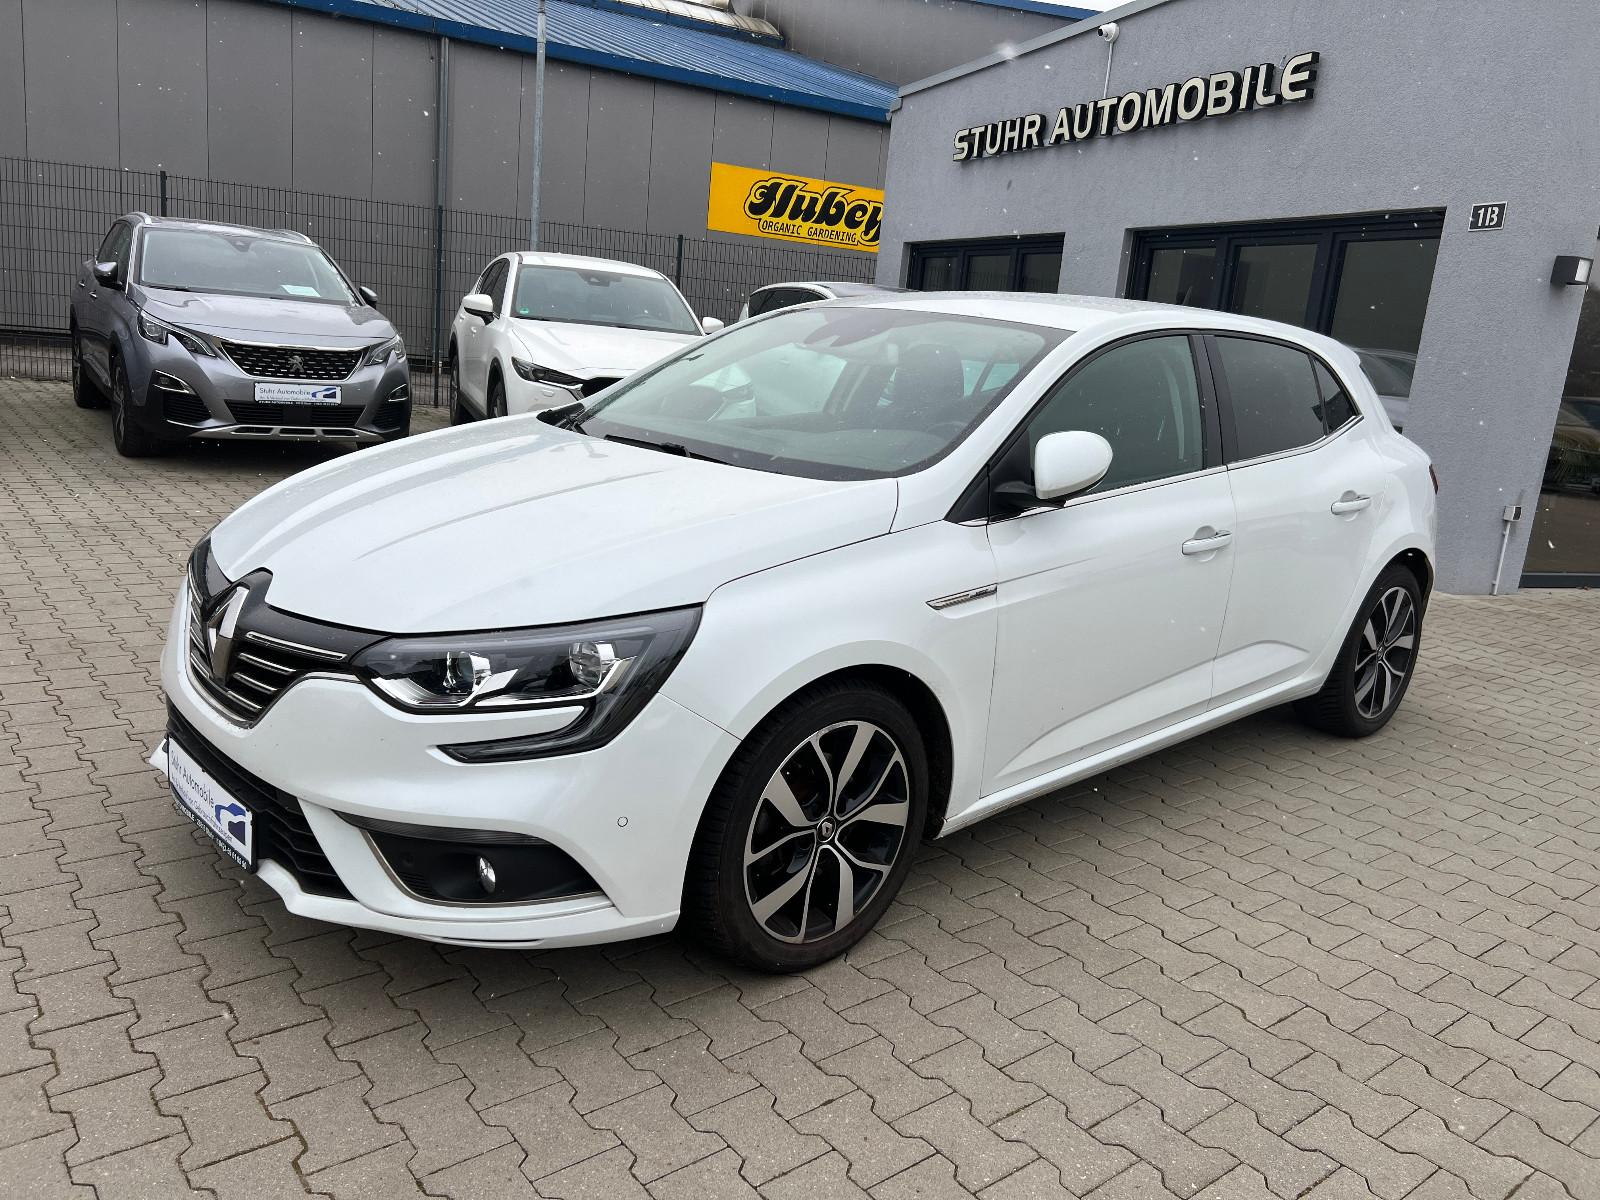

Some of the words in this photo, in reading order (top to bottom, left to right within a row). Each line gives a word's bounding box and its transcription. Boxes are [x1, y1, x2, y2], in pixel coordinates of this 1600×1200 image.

[953, 113, 1045, 161] STUHR
[1049, 52, 1320, 144] AUTOMOBILE
[761, 219, 803, 236] ORGANIC
[807, 226, 857, 243] GARDENING
[1477, 206, 1499, 227] 1B
[182, 767, 215, 809] Automobile
